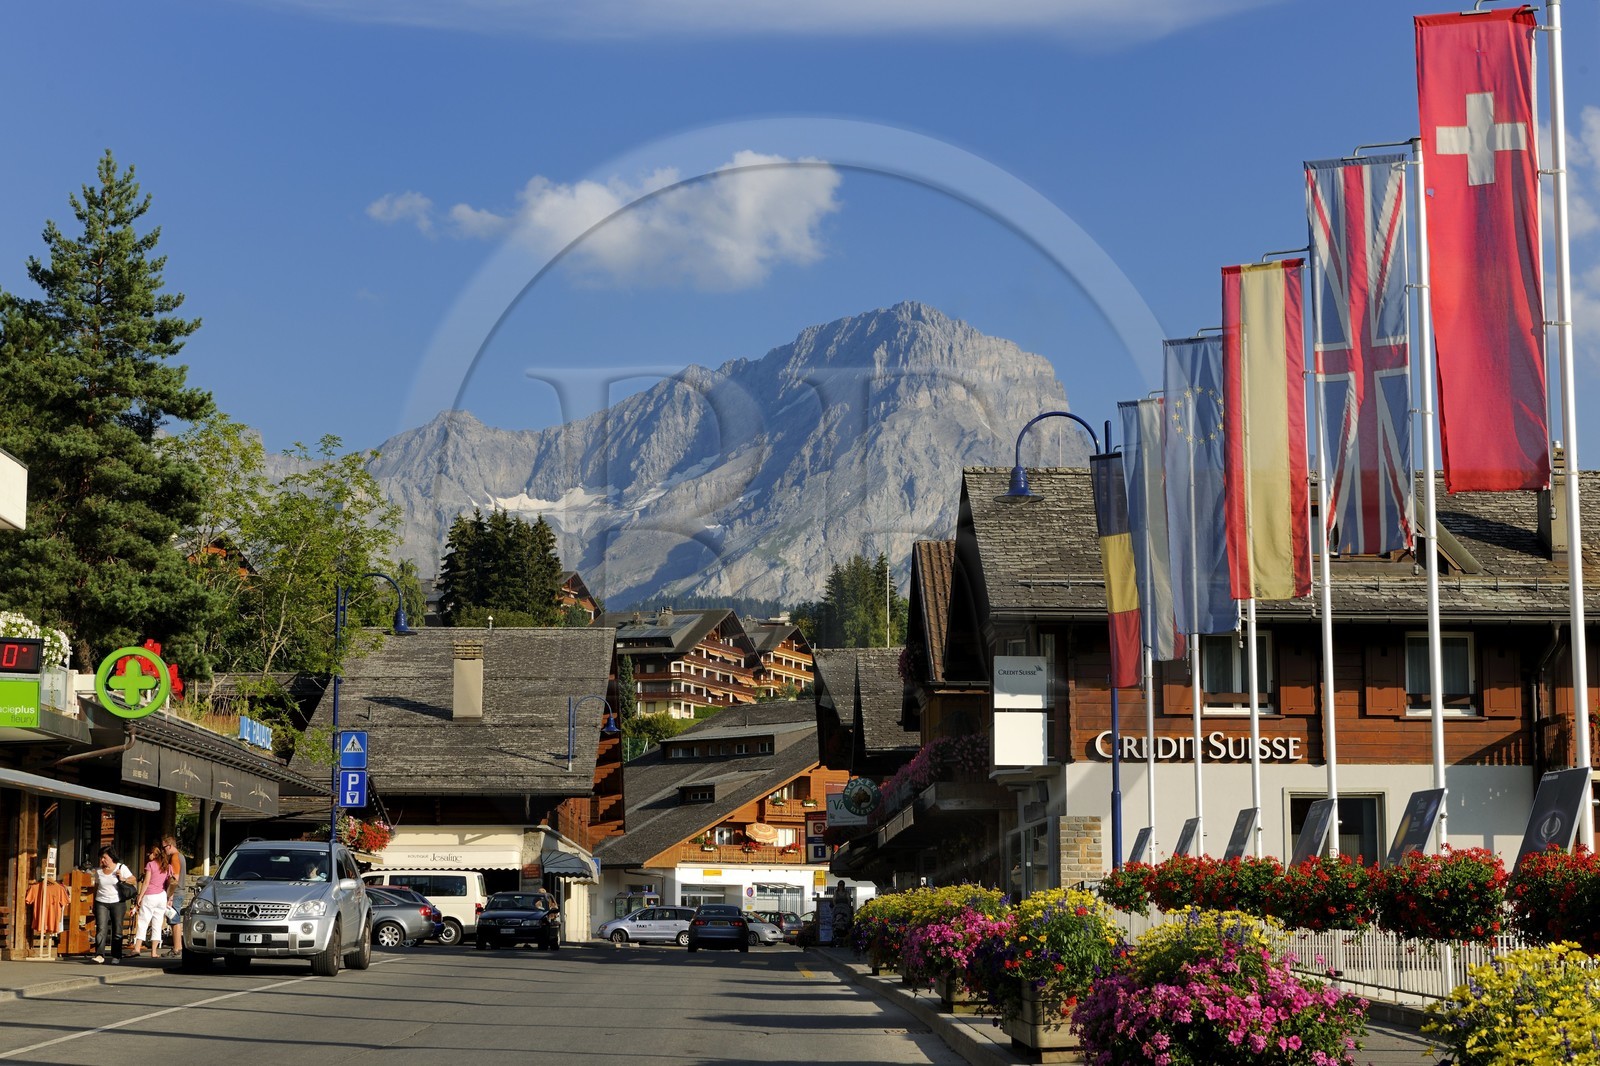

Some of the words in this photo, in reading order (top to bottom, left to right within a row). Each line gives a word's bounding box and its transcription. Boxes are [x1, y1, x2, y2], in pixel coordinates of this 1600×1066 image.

[11, 714, 35, 725] fleury
[1095, 730, 1204, 758] CREDIT
[1208, 731, 1303, 760] SUISSE
[347, 773, 359, 791] P
[844, 778, 878, 796] BOXER
